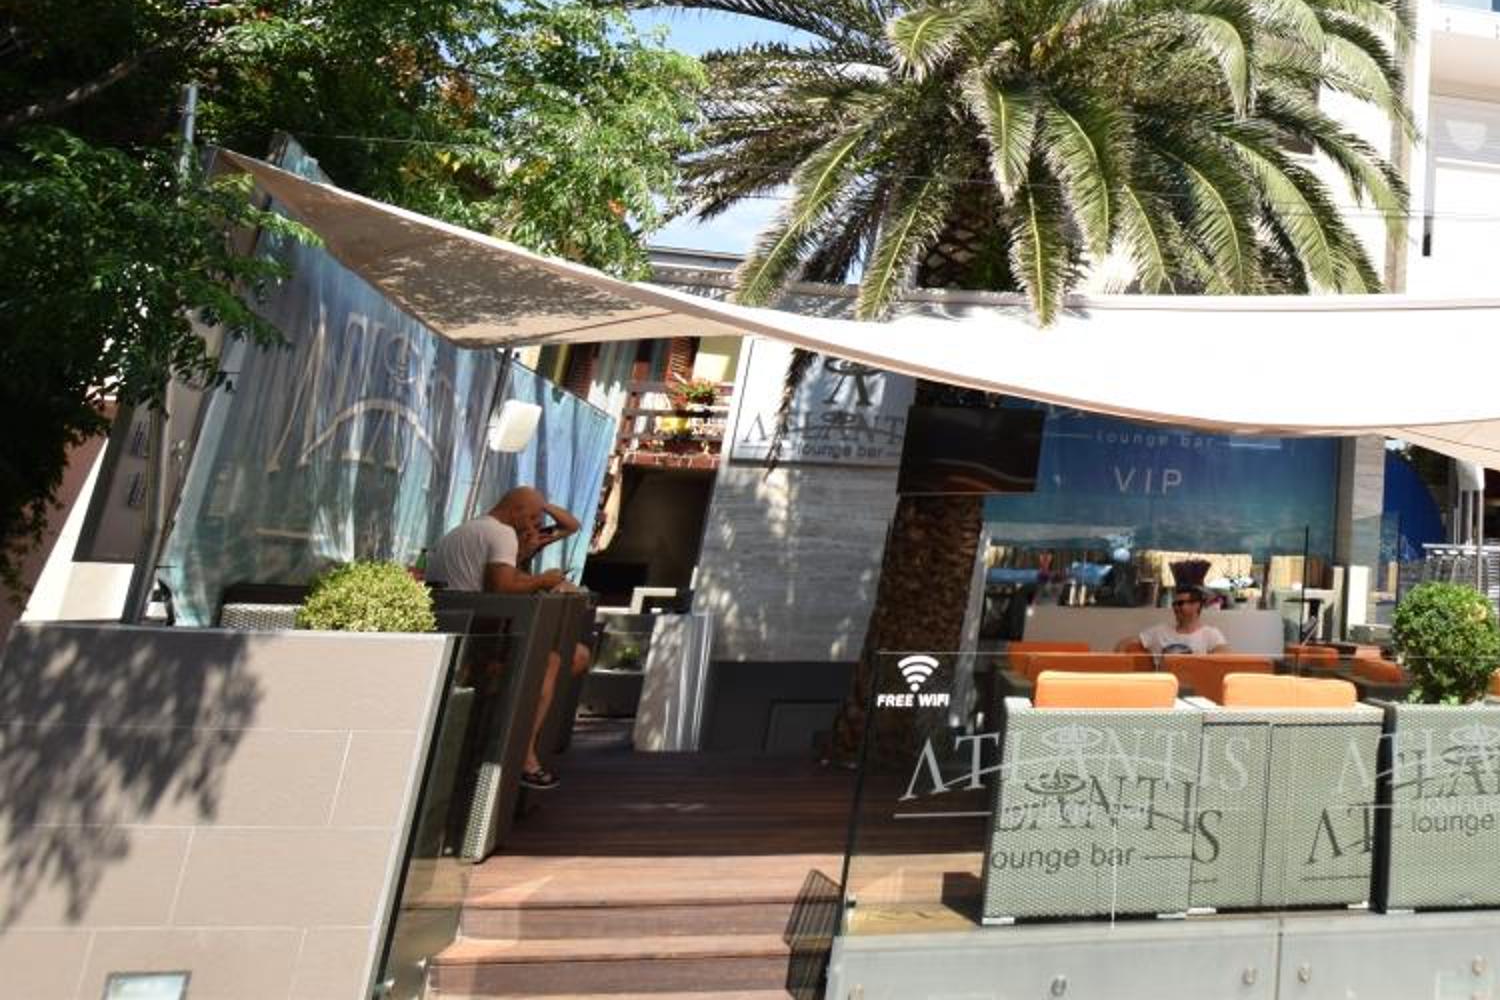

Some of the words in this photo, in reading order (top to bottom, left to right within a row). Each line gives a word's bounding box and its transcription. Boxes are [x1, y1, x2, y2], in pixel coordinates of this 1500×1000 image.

[1113, 465, 1184, 495] VIP
[877, 693, 914, 707] FREE
[918, 693, 950, 707] WIFI
[896, 722, 1252, 801] ATLANTIS
